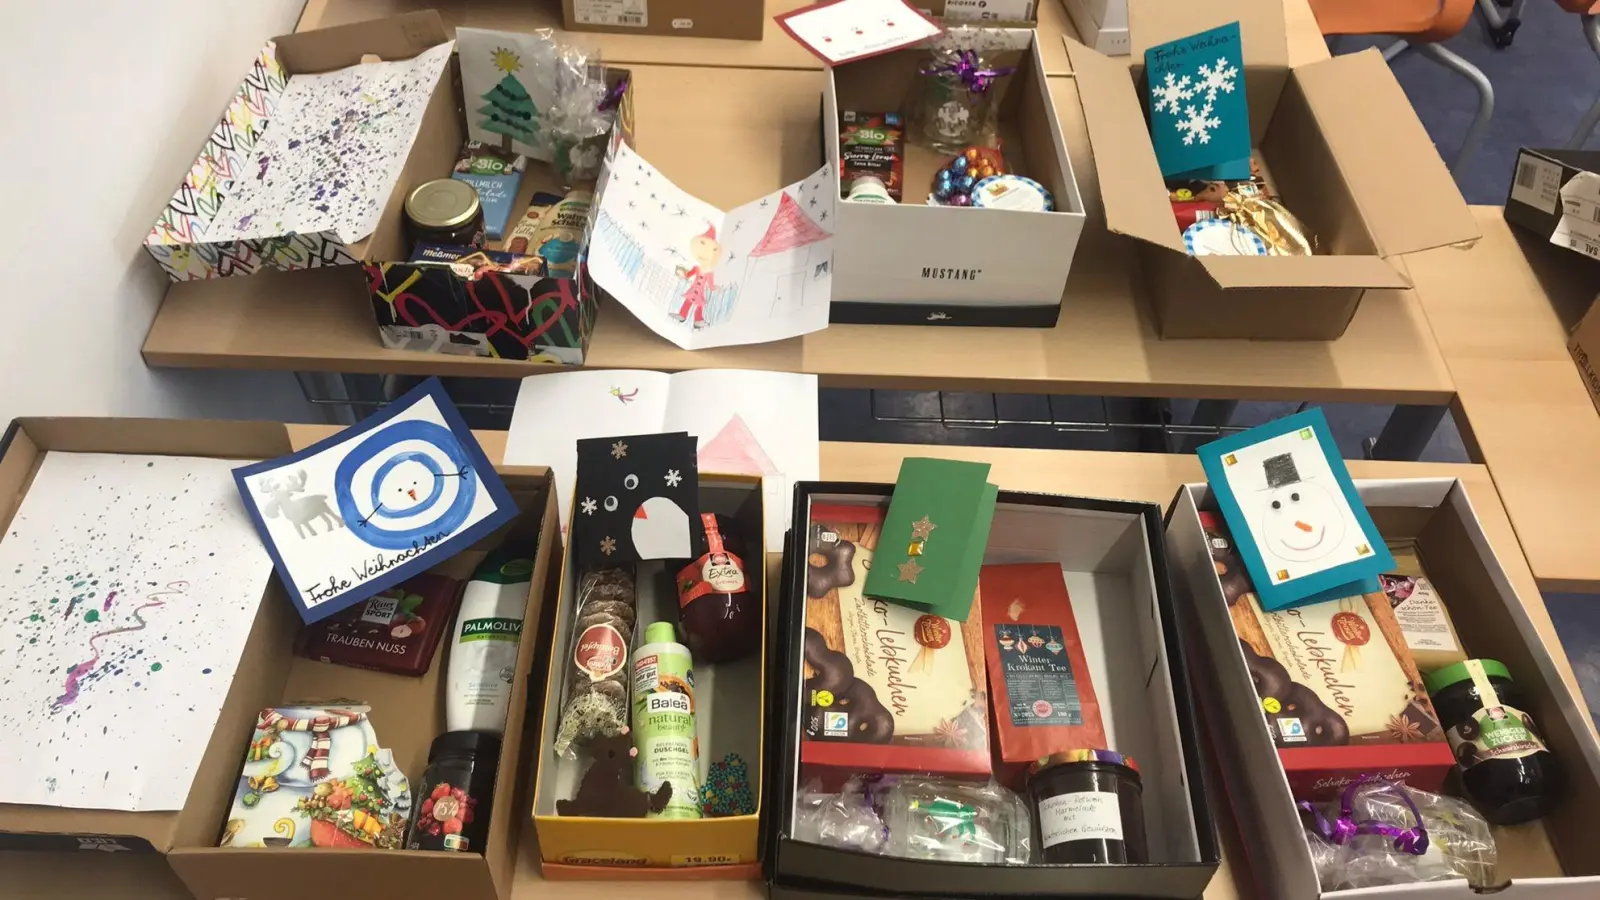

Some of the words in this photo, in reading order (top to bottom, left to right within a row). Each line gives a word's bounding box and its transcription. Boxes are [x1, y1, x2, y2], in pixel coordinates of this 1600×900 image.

[423, 249, 462, 259] Meßmer
[305, 576, 352, 604] Frohe
[351, 531, 452, 581] Weihnachten
[708, 566, 739, 580] Extra
[368, 600, 395, 611] Ritter
[365, 609, 392, 619] SPORT
[326, 633, 374, 649] TRAUBEN
[376, 642, 407, 655] NUSS
[1018, 655, 1050, 664] Winter
[1007, 663, 1046, 672] Krokant
[1048, 664, 1067, 672] Tee
[651, 698, 688, 710] Balea
[648, 714, 692, 727] natural
[1485, 726, 1527, 740] WENIGER
[1491, 734, 1528, 746] ZUCKER
[654, 746, 689, 754] DUSCHGEL
